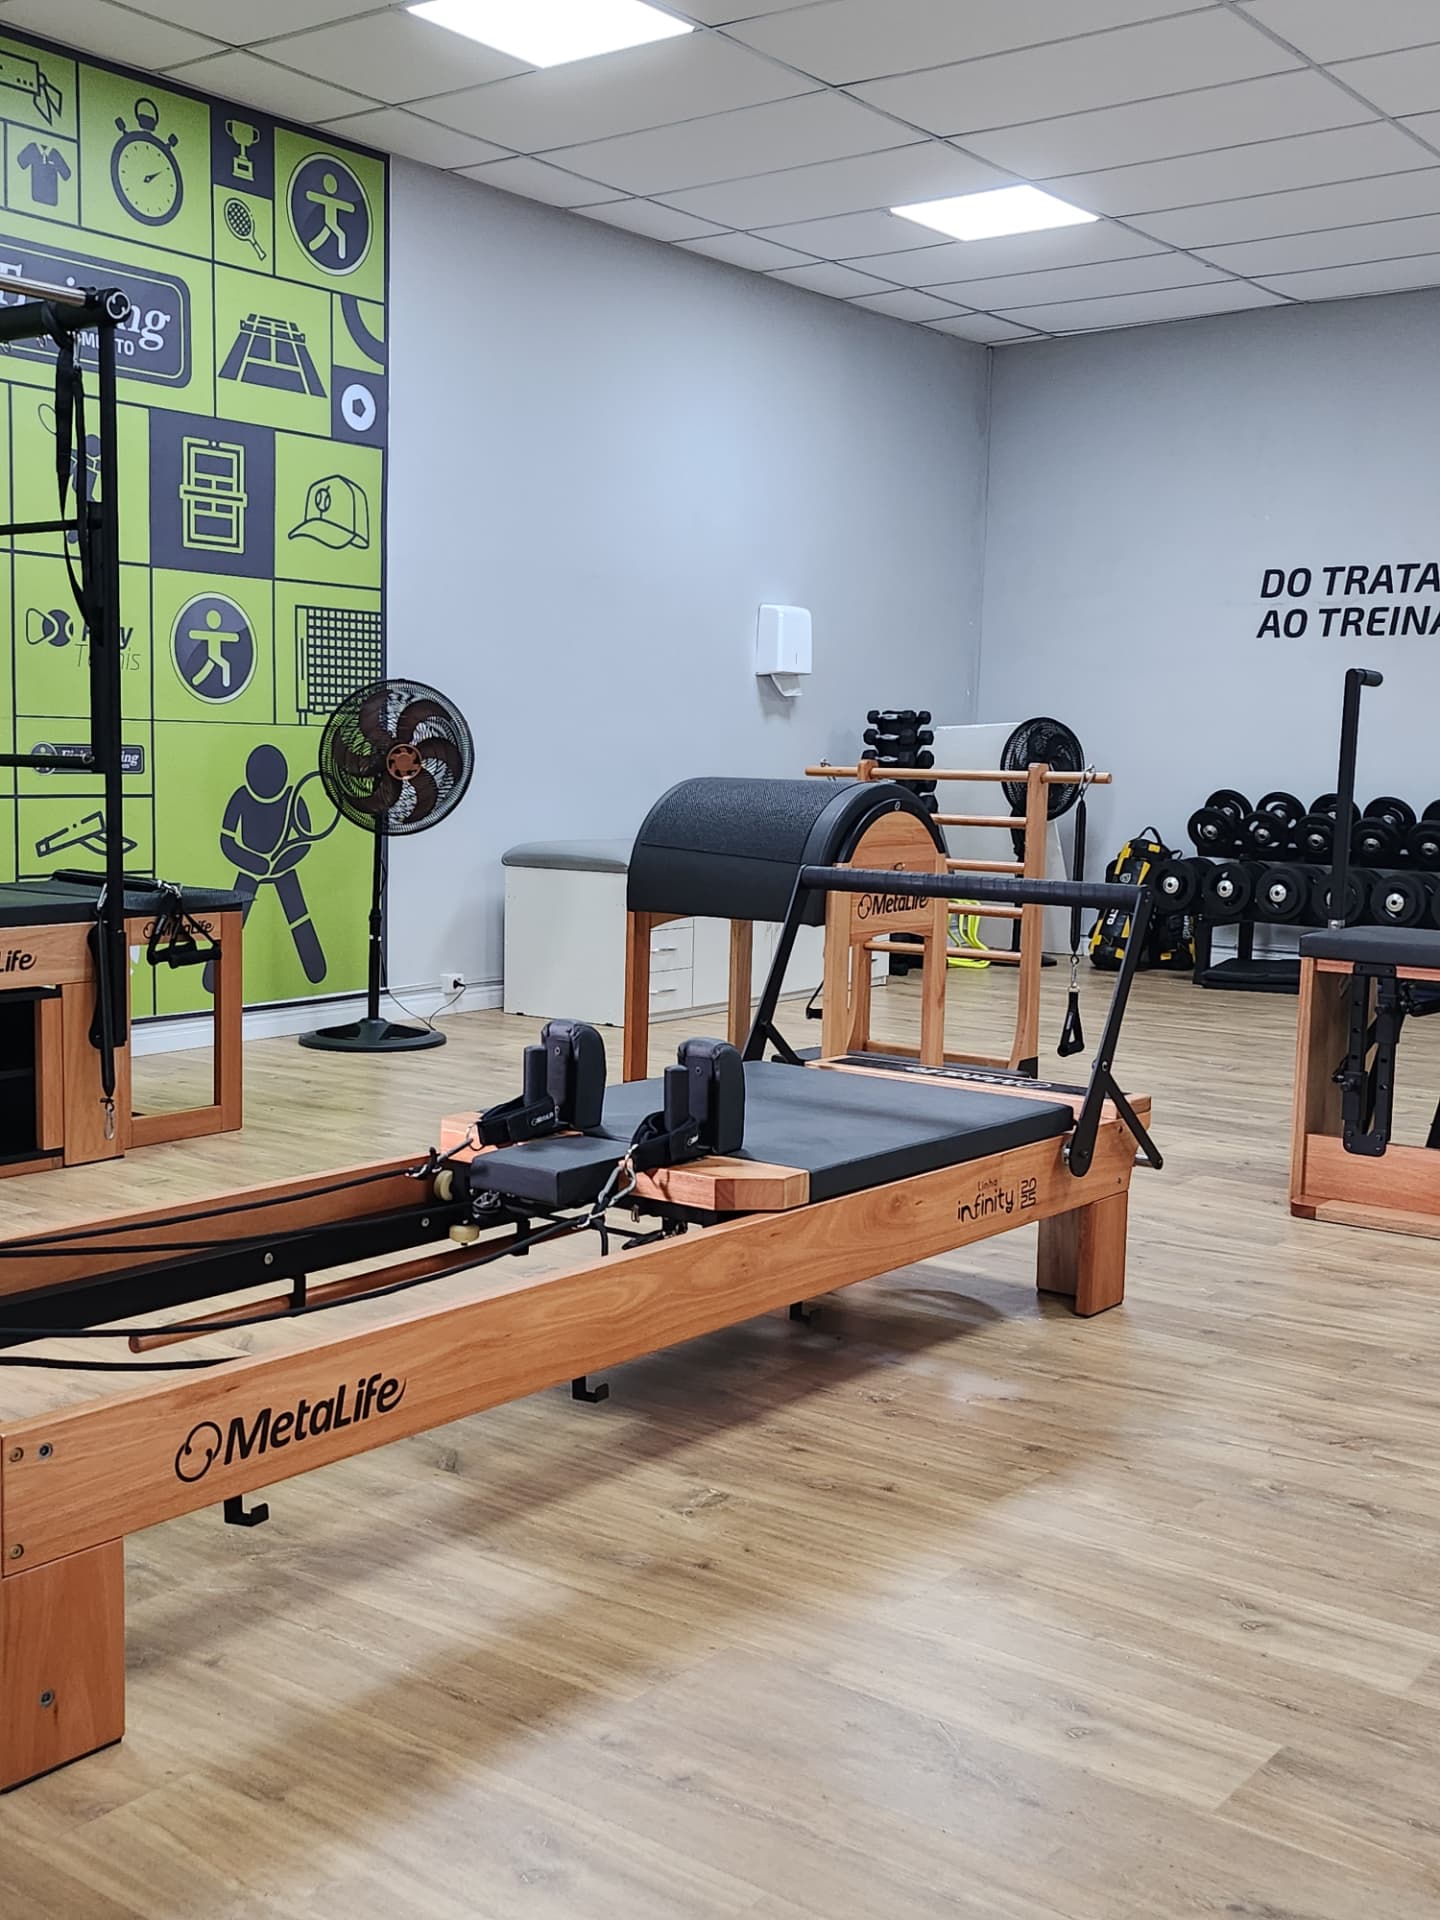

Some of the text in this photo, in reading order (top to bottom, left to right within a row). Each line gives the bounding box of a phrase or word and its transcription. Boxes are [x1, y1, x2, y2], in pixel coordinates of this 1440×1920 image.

[1260, 562, 1440, 598] DO TRATA
[1256, 608, 1308, 638] AO
[957, 1187, 1014, 1222] infinity
[224, 1372, 408, 1466] MetaLife
